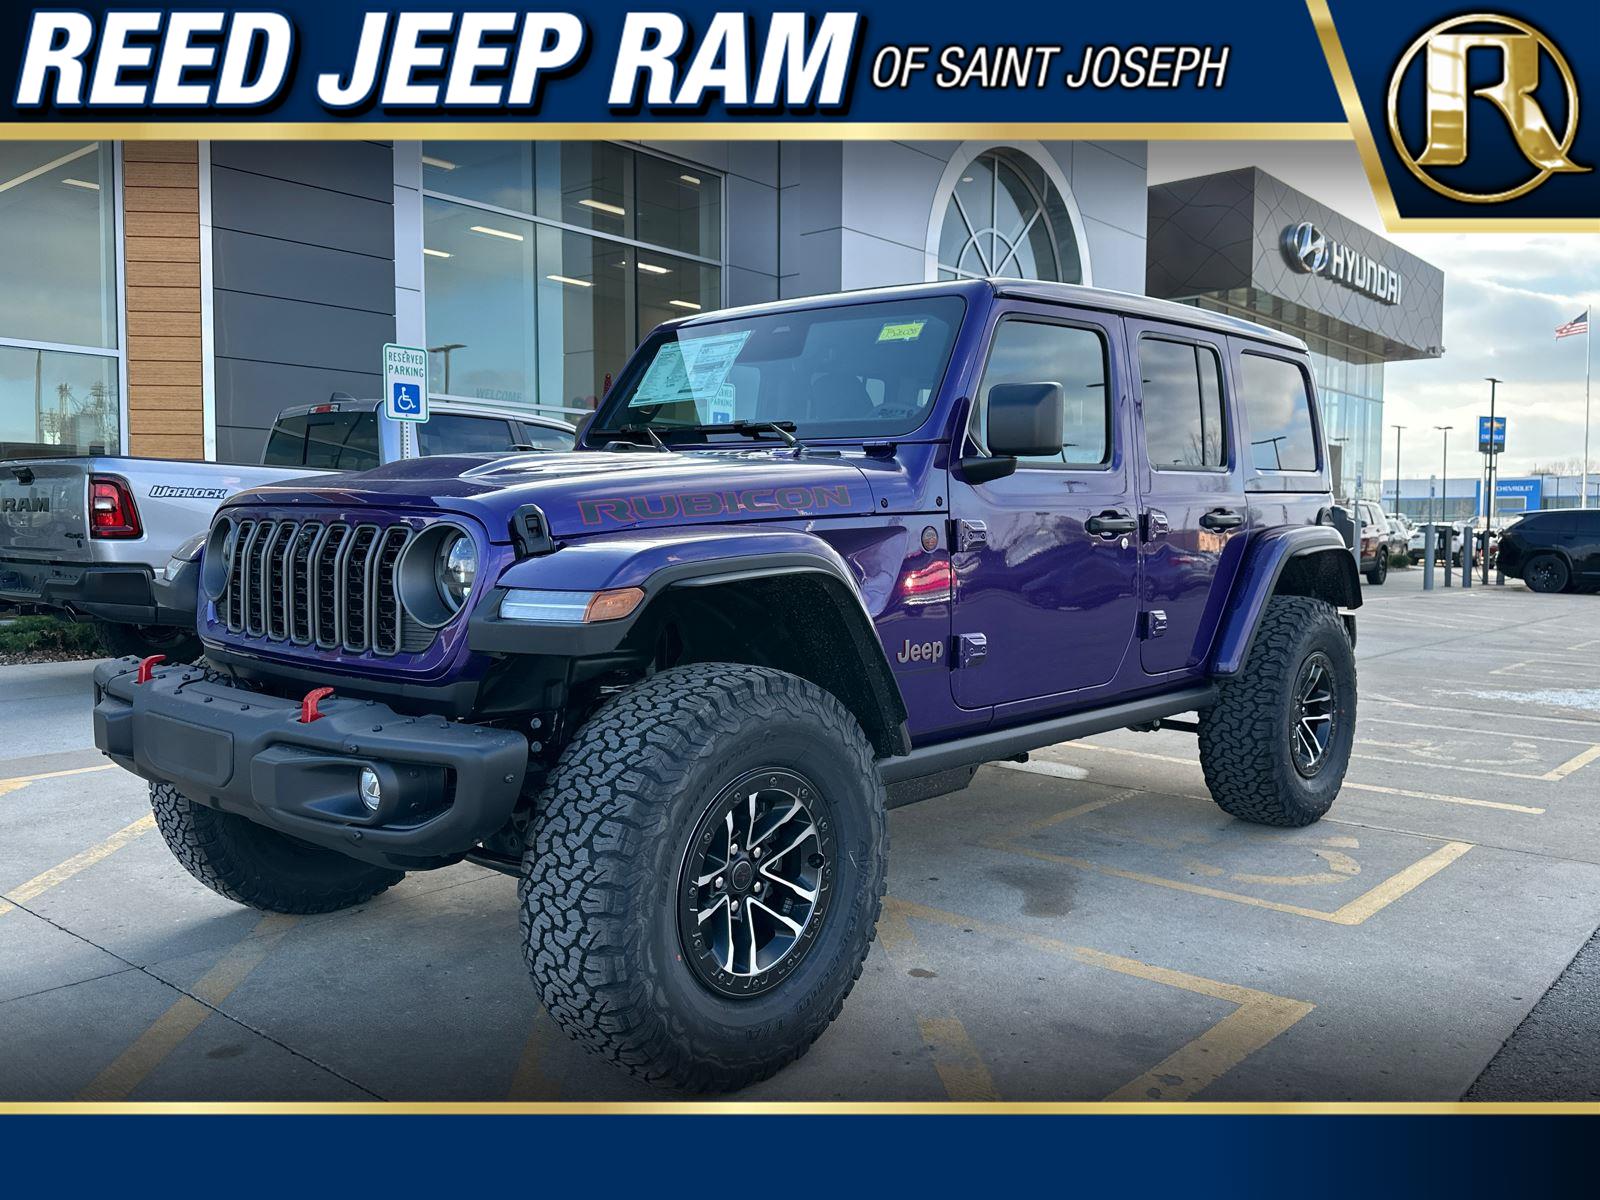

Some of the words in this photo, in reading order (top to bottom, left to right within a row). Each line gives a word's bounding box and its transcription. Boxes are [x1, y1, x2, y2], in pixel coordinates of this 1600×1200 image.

[1332, 240, 1402, 305] HYUNDAI
[388, 351, 424, 365] RESERVED
[388, 364, 424, 378] PARKING
[149, 485, 228, 499] WARLOCK
[1, 497, 50, 512] RAM
[577, 485, 852, 526] RUBICON
[896, 639, 944, 664] Jeep
